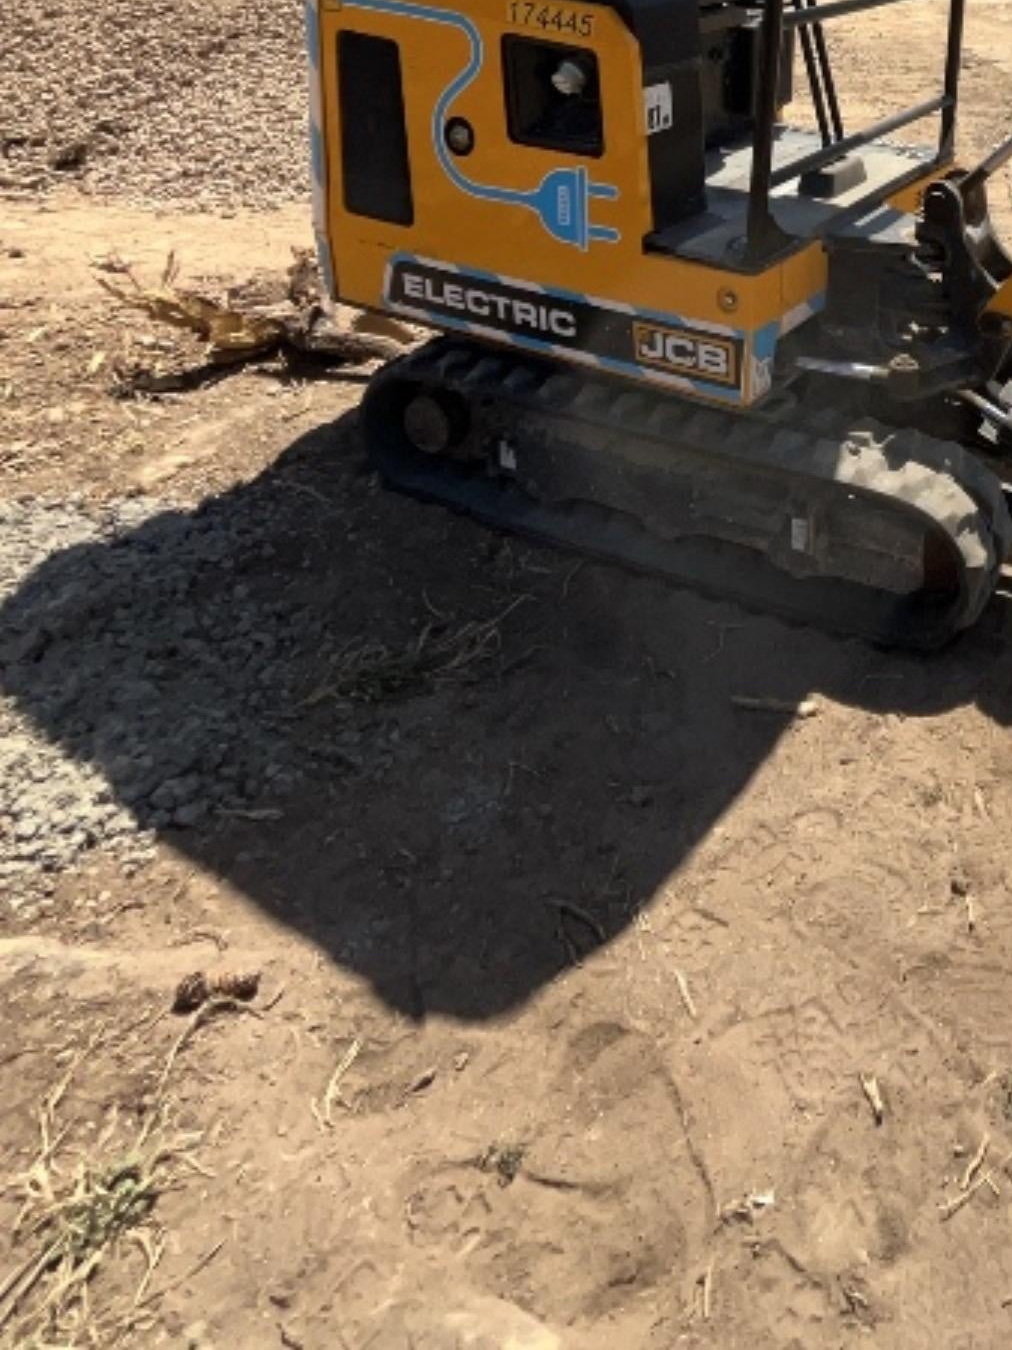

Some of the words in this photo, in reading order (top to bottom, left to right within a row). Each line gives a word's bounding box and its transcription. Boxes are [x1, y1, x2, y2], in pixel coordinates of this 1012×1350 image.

[510, 1, 595, 37] 174445
[402, 272, 577, 337] ELECTRIC
[641, 332, 728, 374] JCB
